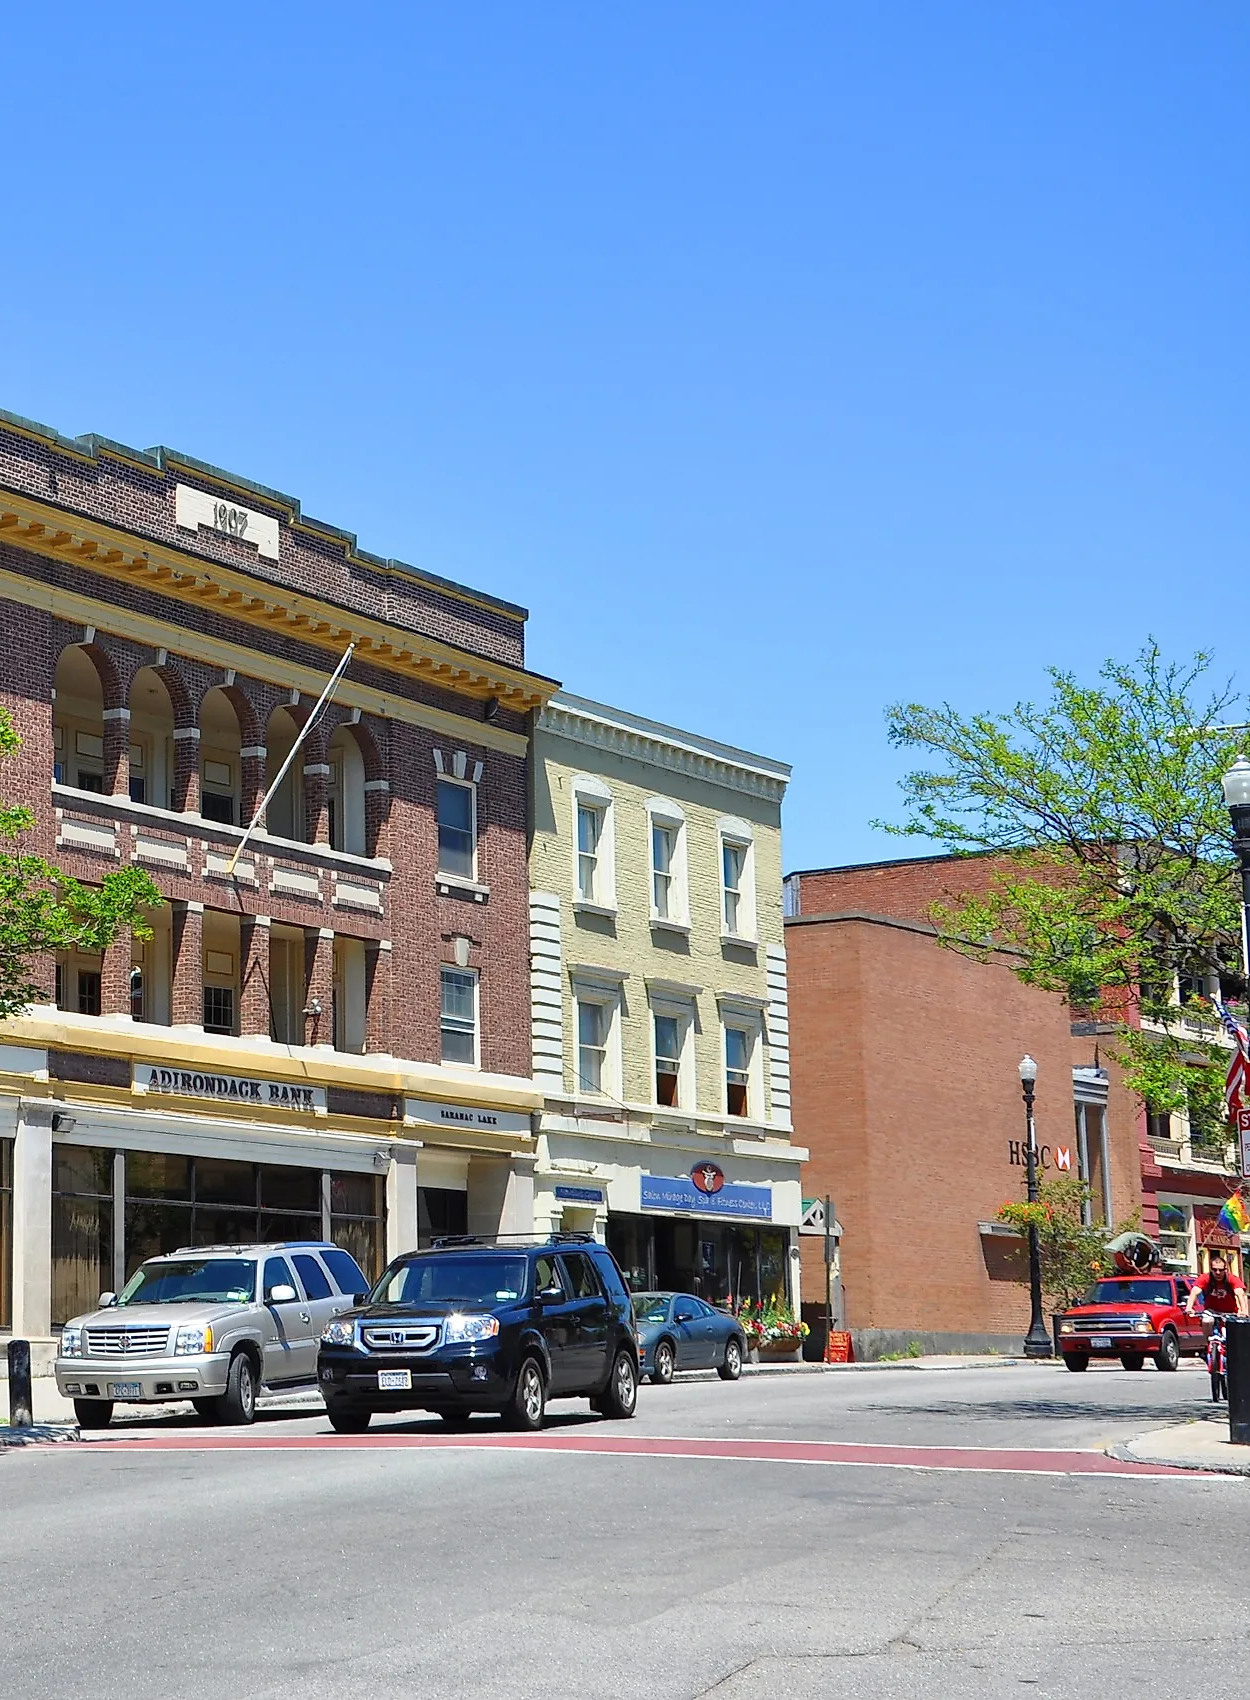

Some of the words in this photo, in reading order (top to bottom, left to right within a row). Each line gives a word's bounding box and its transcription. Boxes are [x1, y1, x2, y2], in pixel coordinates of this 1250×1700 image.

[213, 502, 248, 537] 1907
[150, 1069, 261, 1099] ADIRONDACK
[268, 1084, 314, 1105] BANK
[478, 1115, 497, 1125] LAKE
